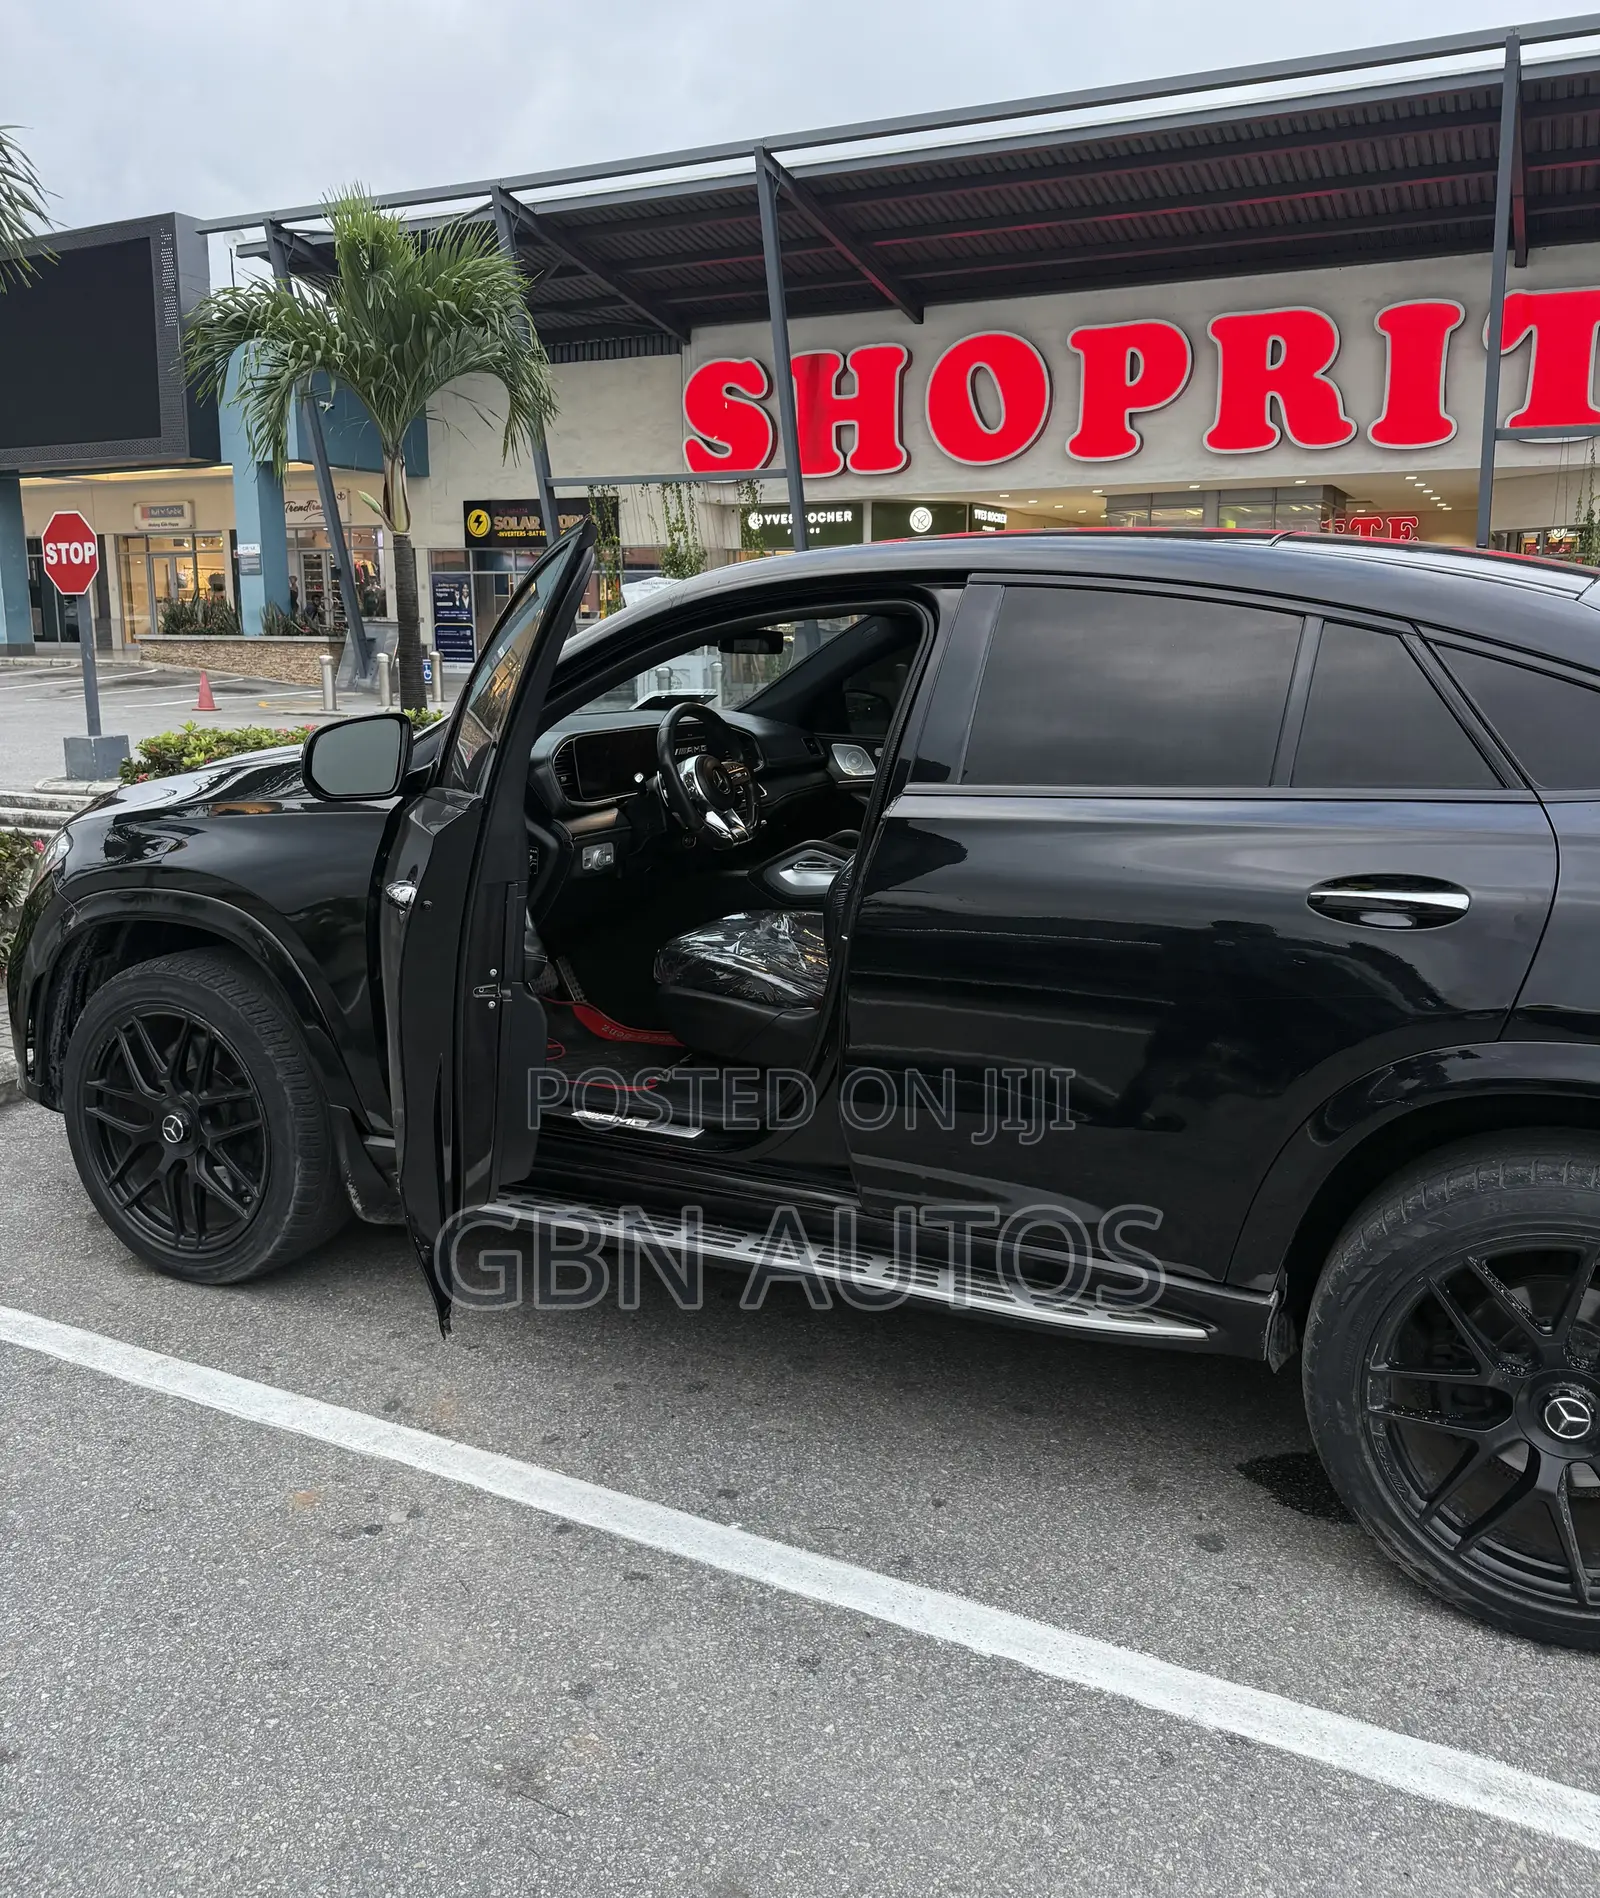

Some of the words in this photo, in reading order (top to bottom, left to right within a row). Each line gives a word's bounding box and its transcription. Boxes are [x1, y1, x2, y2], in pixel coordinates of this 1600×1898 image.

[493, 515, 541, 531] SOLAR
[804, 510, 852, 524] OCHER
[45, 541, 96, 565] STOP
